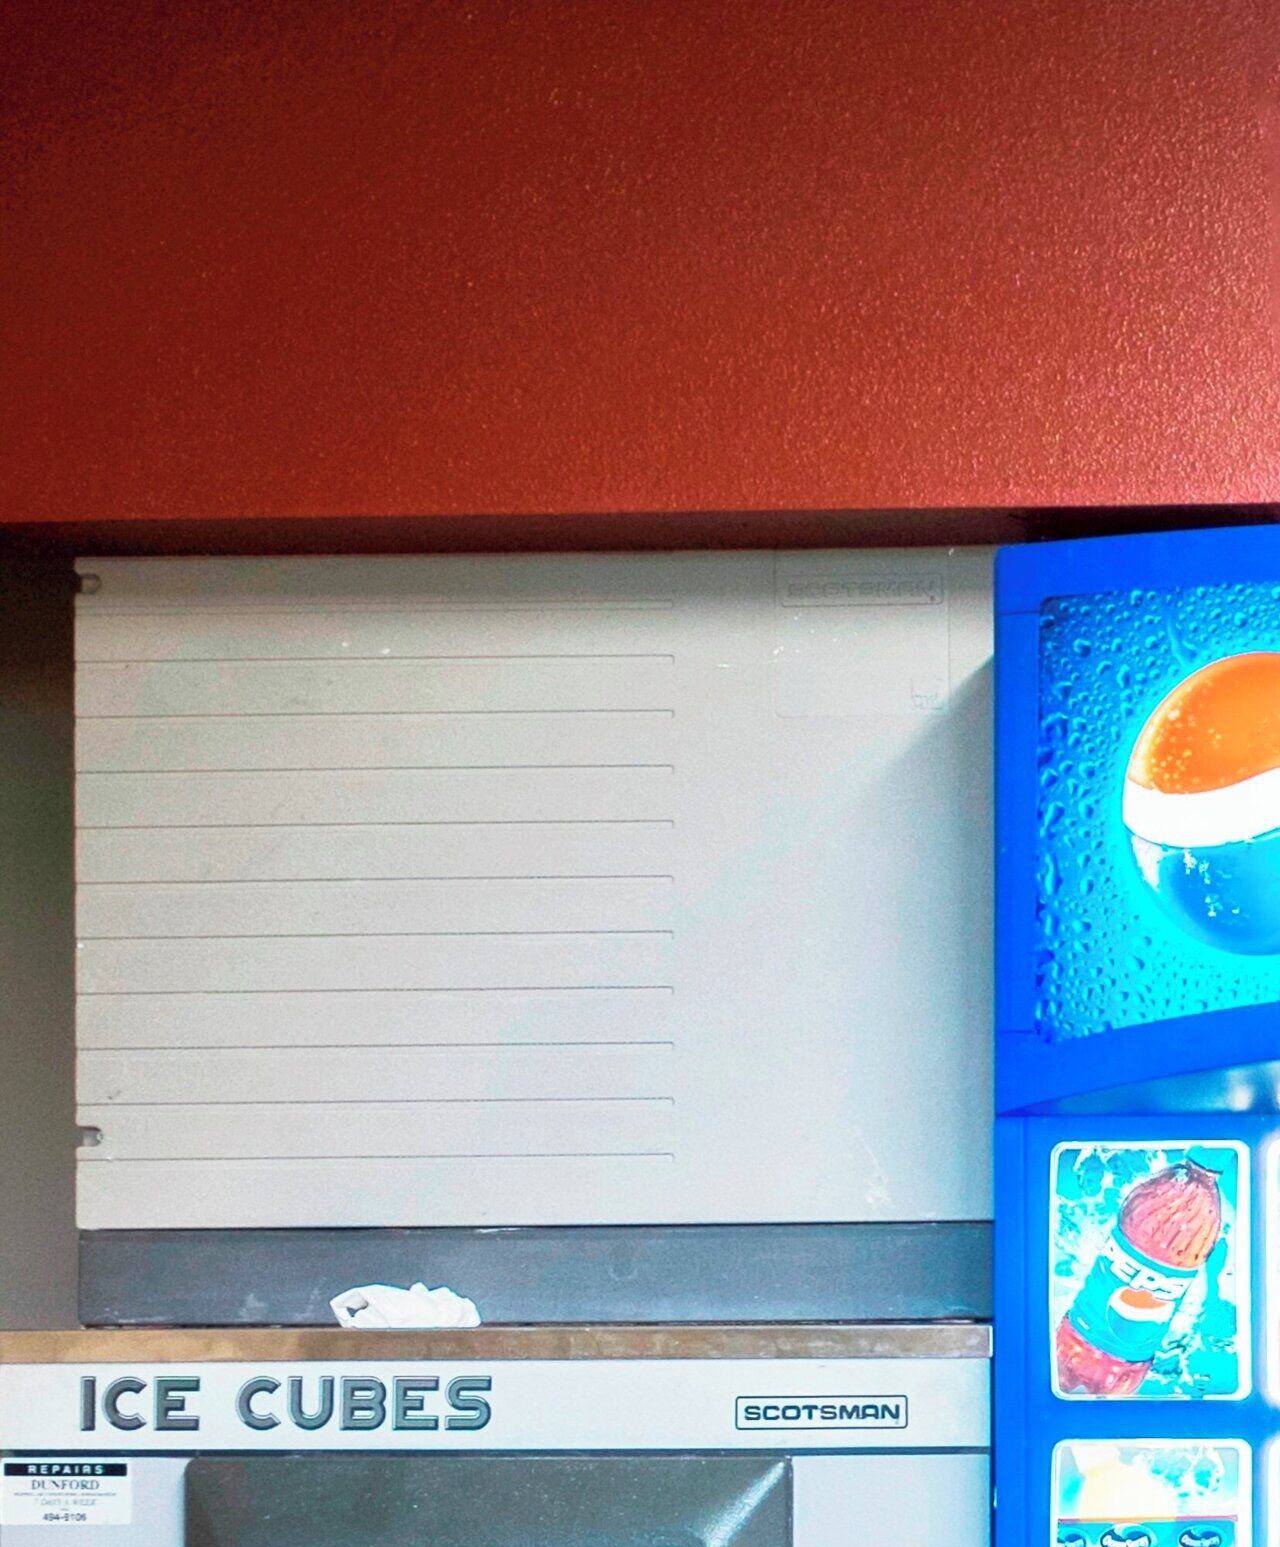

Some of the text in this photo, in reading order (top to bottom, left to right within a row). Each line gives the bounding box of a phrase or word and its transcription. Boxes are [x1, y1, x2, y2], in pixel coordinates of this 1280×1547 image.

[79, 1374, 494, 1433] ICE CUBES
[743, 1402, 903, 1422] SCOTSMAN
[27, 1464, 105, 1475] REPAIRS
